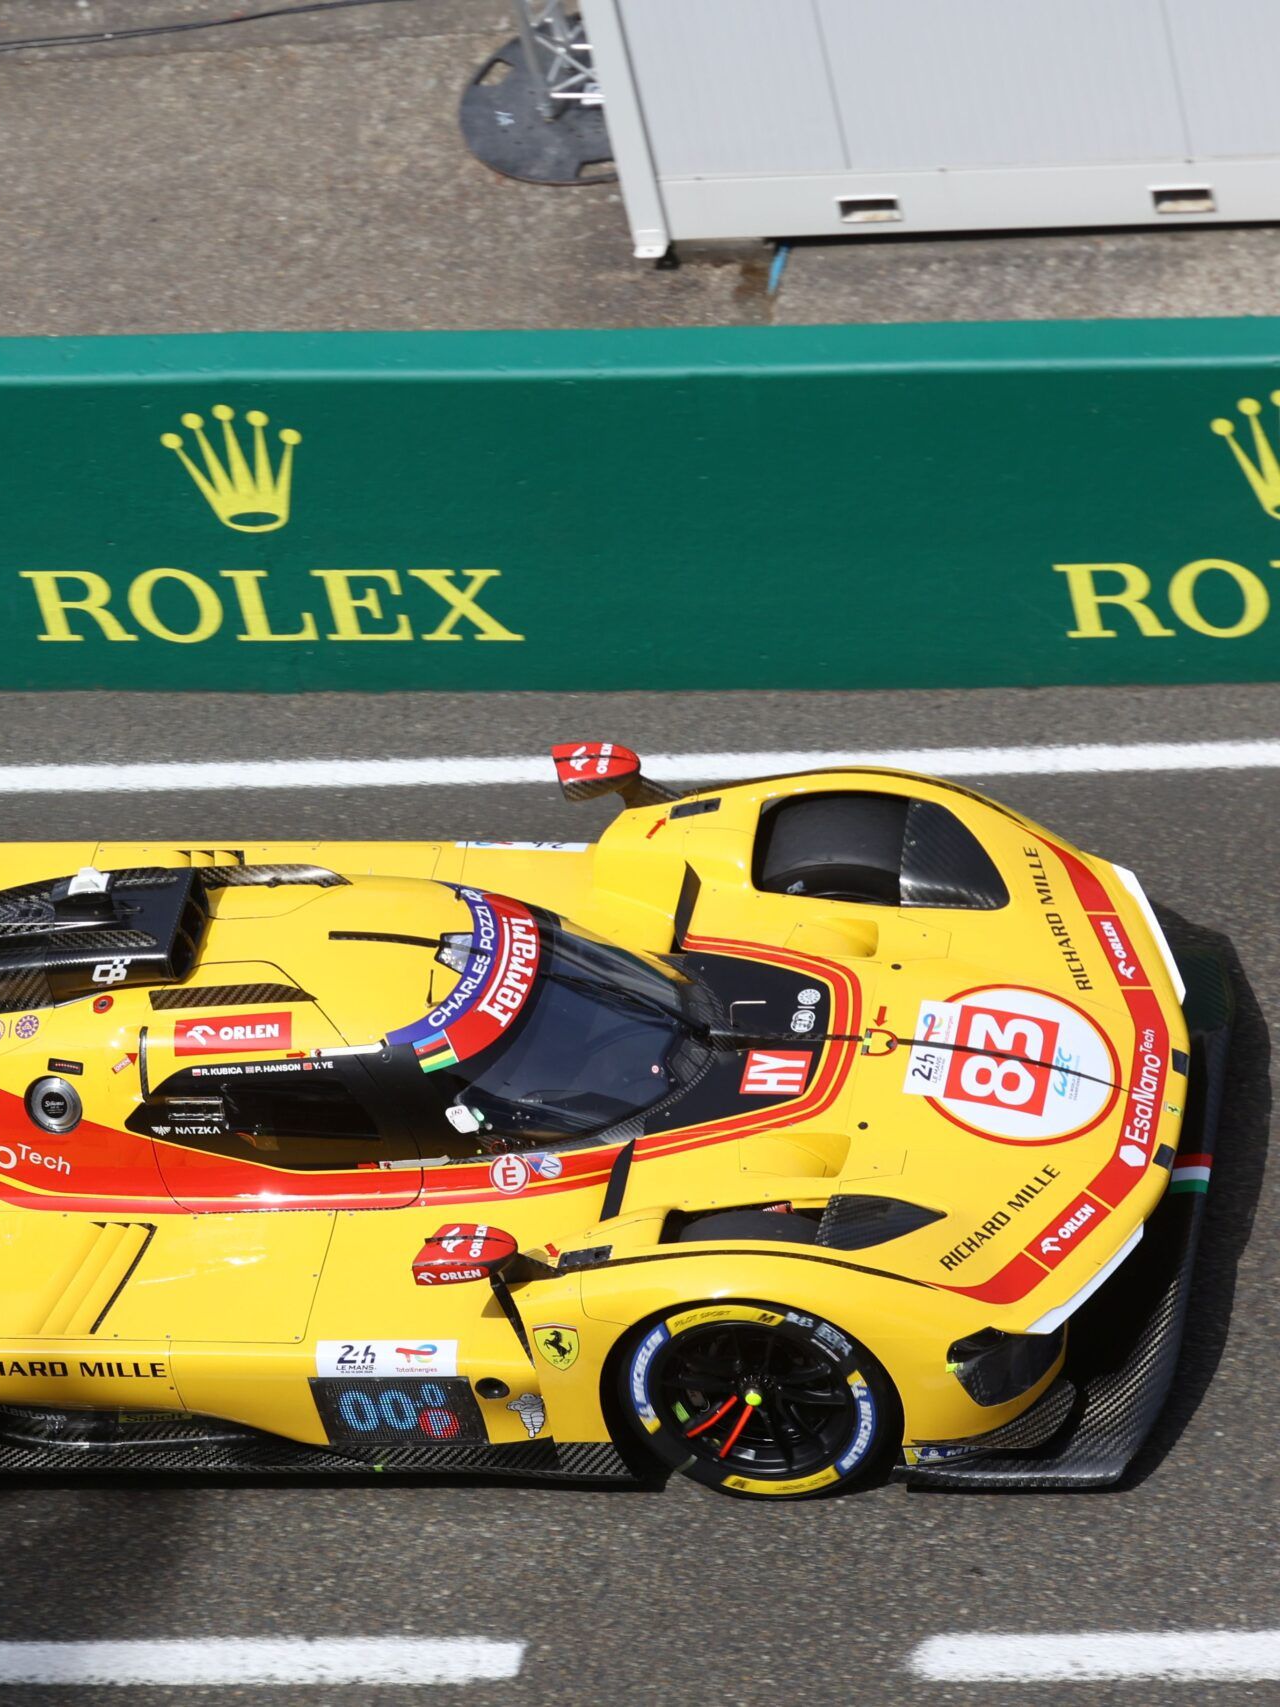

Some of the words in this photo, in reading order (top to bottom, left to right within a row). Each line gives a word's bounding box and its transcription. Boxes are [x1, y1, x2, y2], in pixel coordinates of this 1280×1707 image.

[19, 567, 526, 644] ROLEX
[1052, 558, 1280, 639] RO
[1023, 846, 1055, 905] MILLE
[1046, 912, 1093, 991] RICHARD
[1100, 921, 1127, 959] ORLEN
[428, 955, 491, 1027] CHARLES
[475, 905, 495, 951] POZZI
[478, 917, 538, 1027] Ferrari
[219, 1023, 280, 1041] ORLEN
[210, 1067, 243, 1076] KUBICA
[264, 1064, 301, 1073] HANSON
[322, 1061, 334, 1069] YE
[744, 1053, 806, 1093] HY
[960, 1013, 1044, 1106] 83
[175, 1126, 221, 1135] NATZKA
[939, 1210, 1011, 1271] RICHARD
[1007, 1164, 1060, 1212] MILLE
[1058, 1203, 1096, 1239] ORLEN
[440, 1269, 482, 1281] ORLEN
[79, 1361, 168, 1379] MILLE
[337, 1344, 376, 1364] 24h
[632, 1328, 665, 1403] MICHELIN
